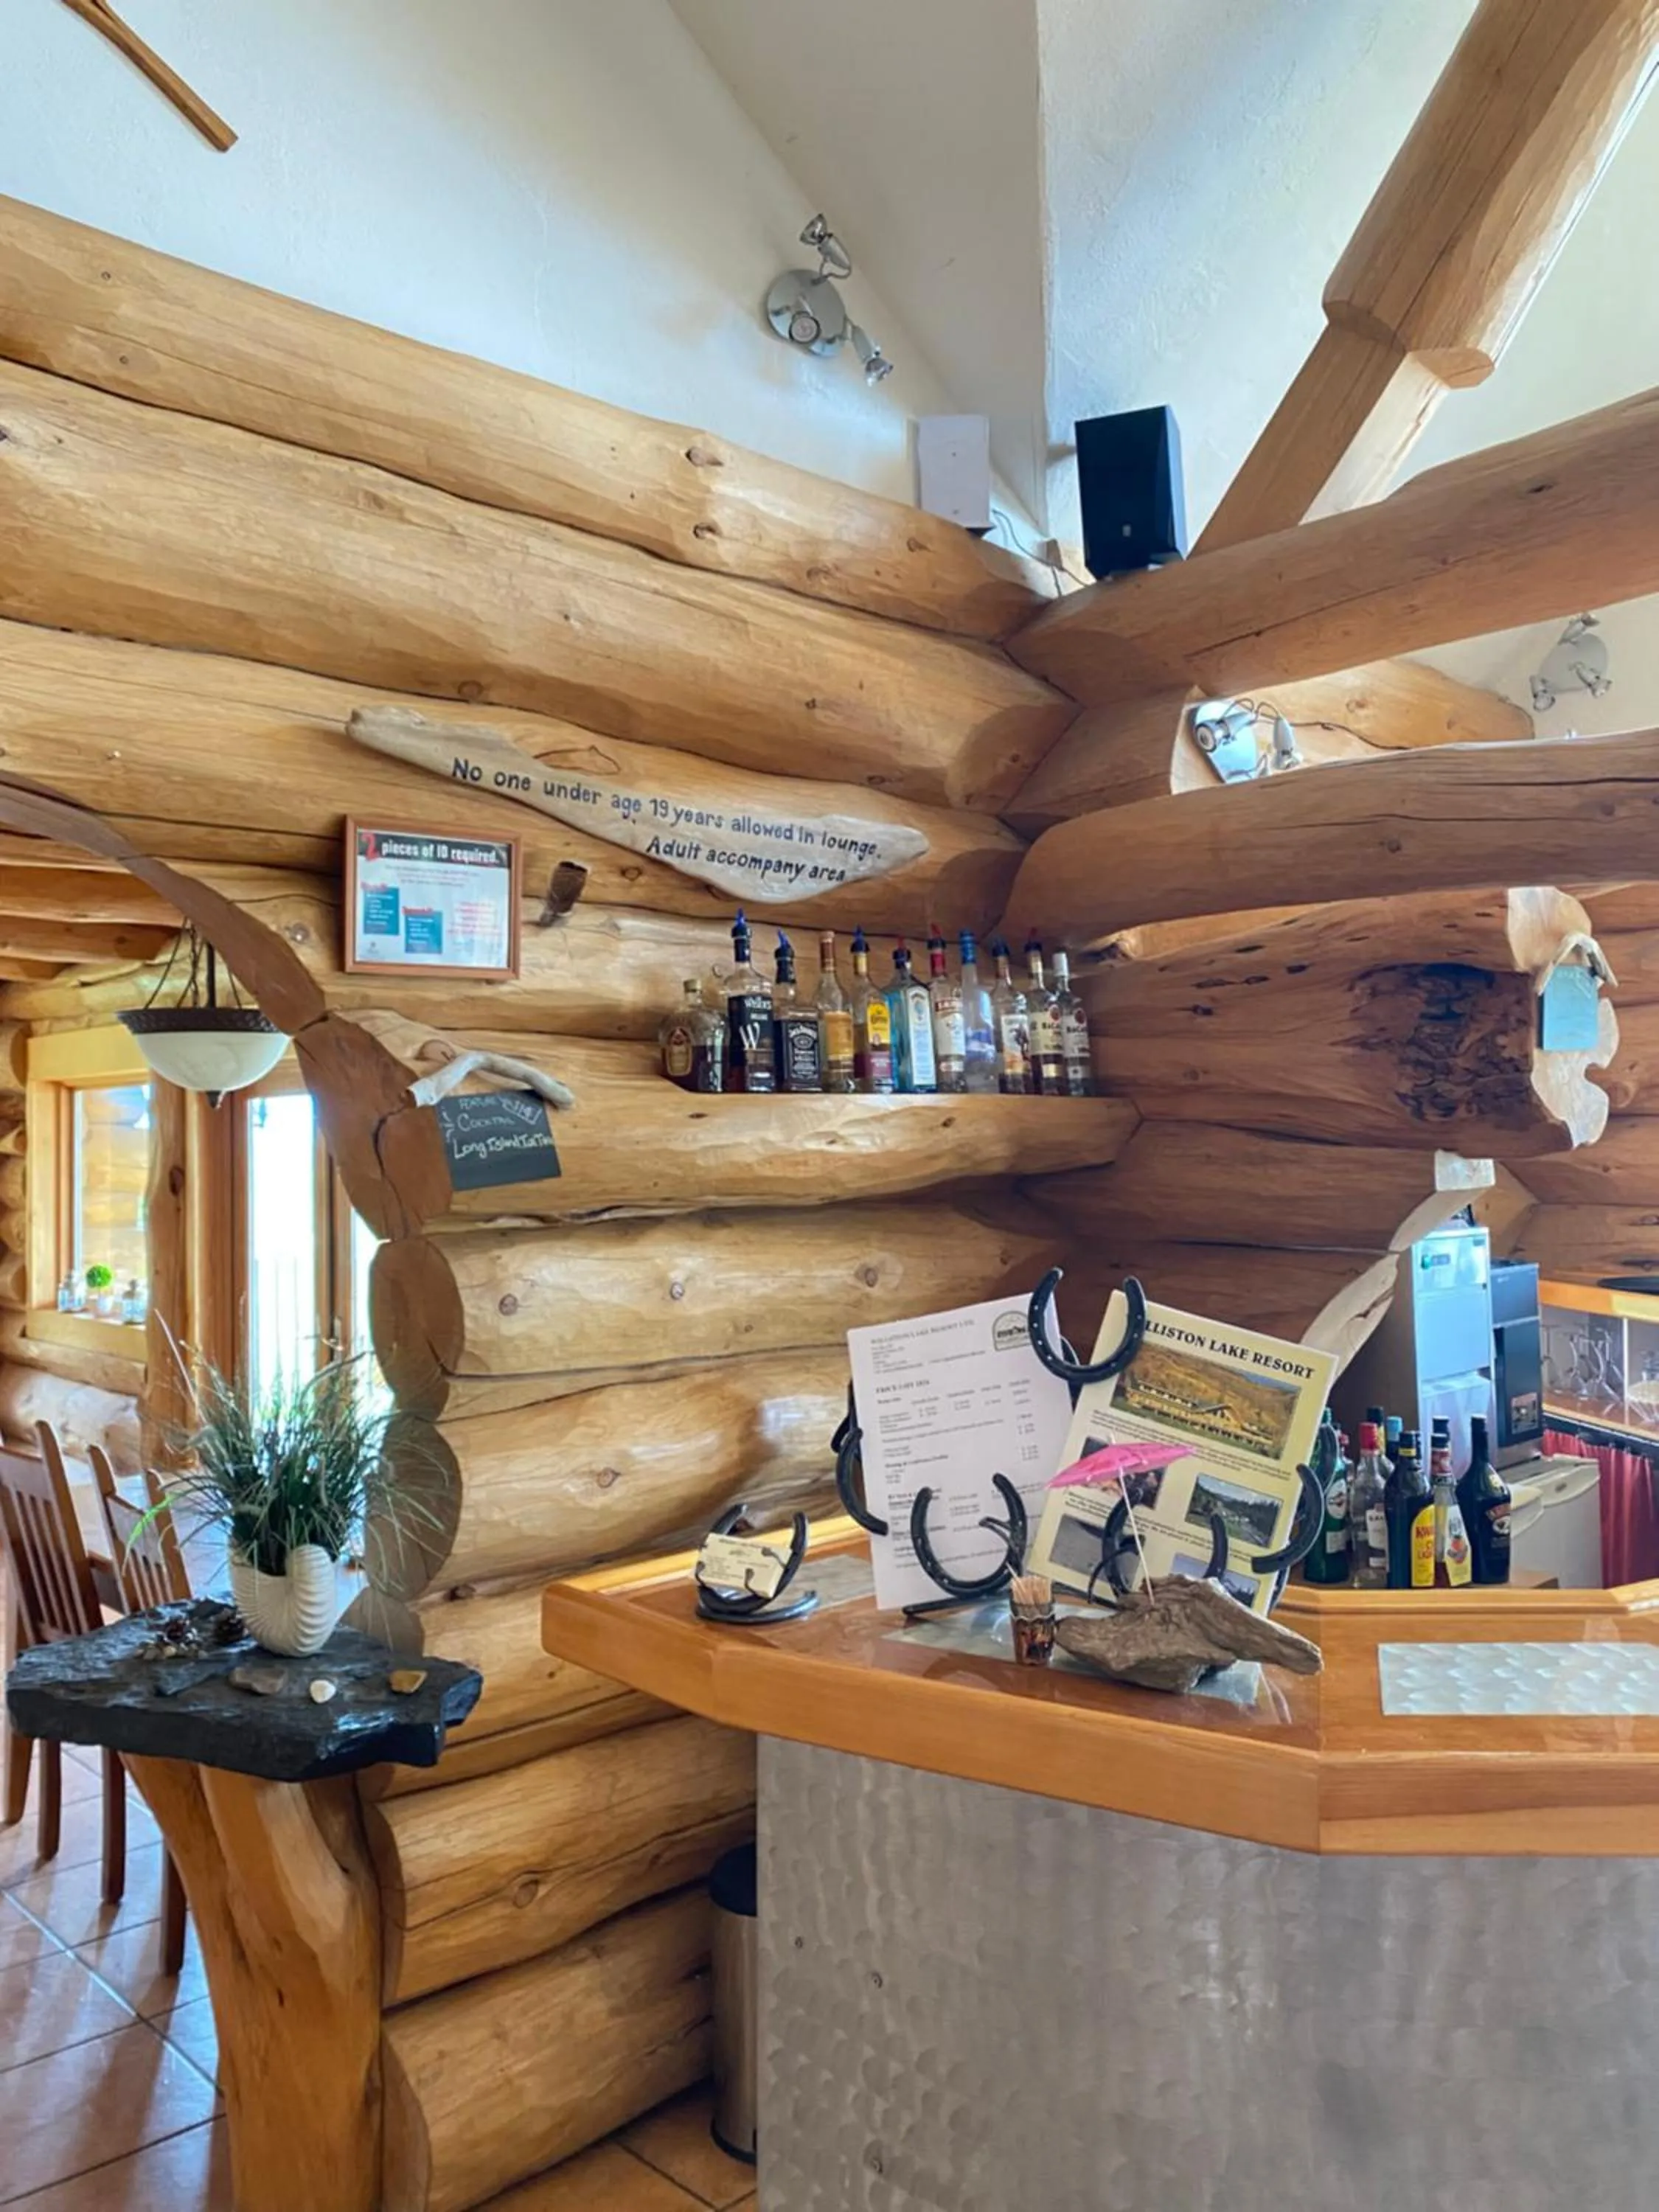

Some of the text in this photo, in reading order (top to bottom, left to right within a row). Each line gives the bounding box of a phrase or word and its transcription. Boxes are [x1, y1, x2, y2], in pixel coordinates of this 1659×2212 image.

[452, 757, 482, 782] No
[494, 771, 531, 791] one
[544, 782, 602, 804] under
[611, 793, 642, 820] age
[650, 798, 669, 818] 19
[671, 806, 724, 827] years
[731, 815, 794, 841] allowed
[361, 831, 380, 861] 2
[381, 838, 419, 856] pieces
[422, 843, 435, 858] of
[437, 844, 448, 859] ID
[646, 835, 847, 884] Adult accompany area
[1145, 1320, 1315, 1380] LLISTON LAKE RESORT
